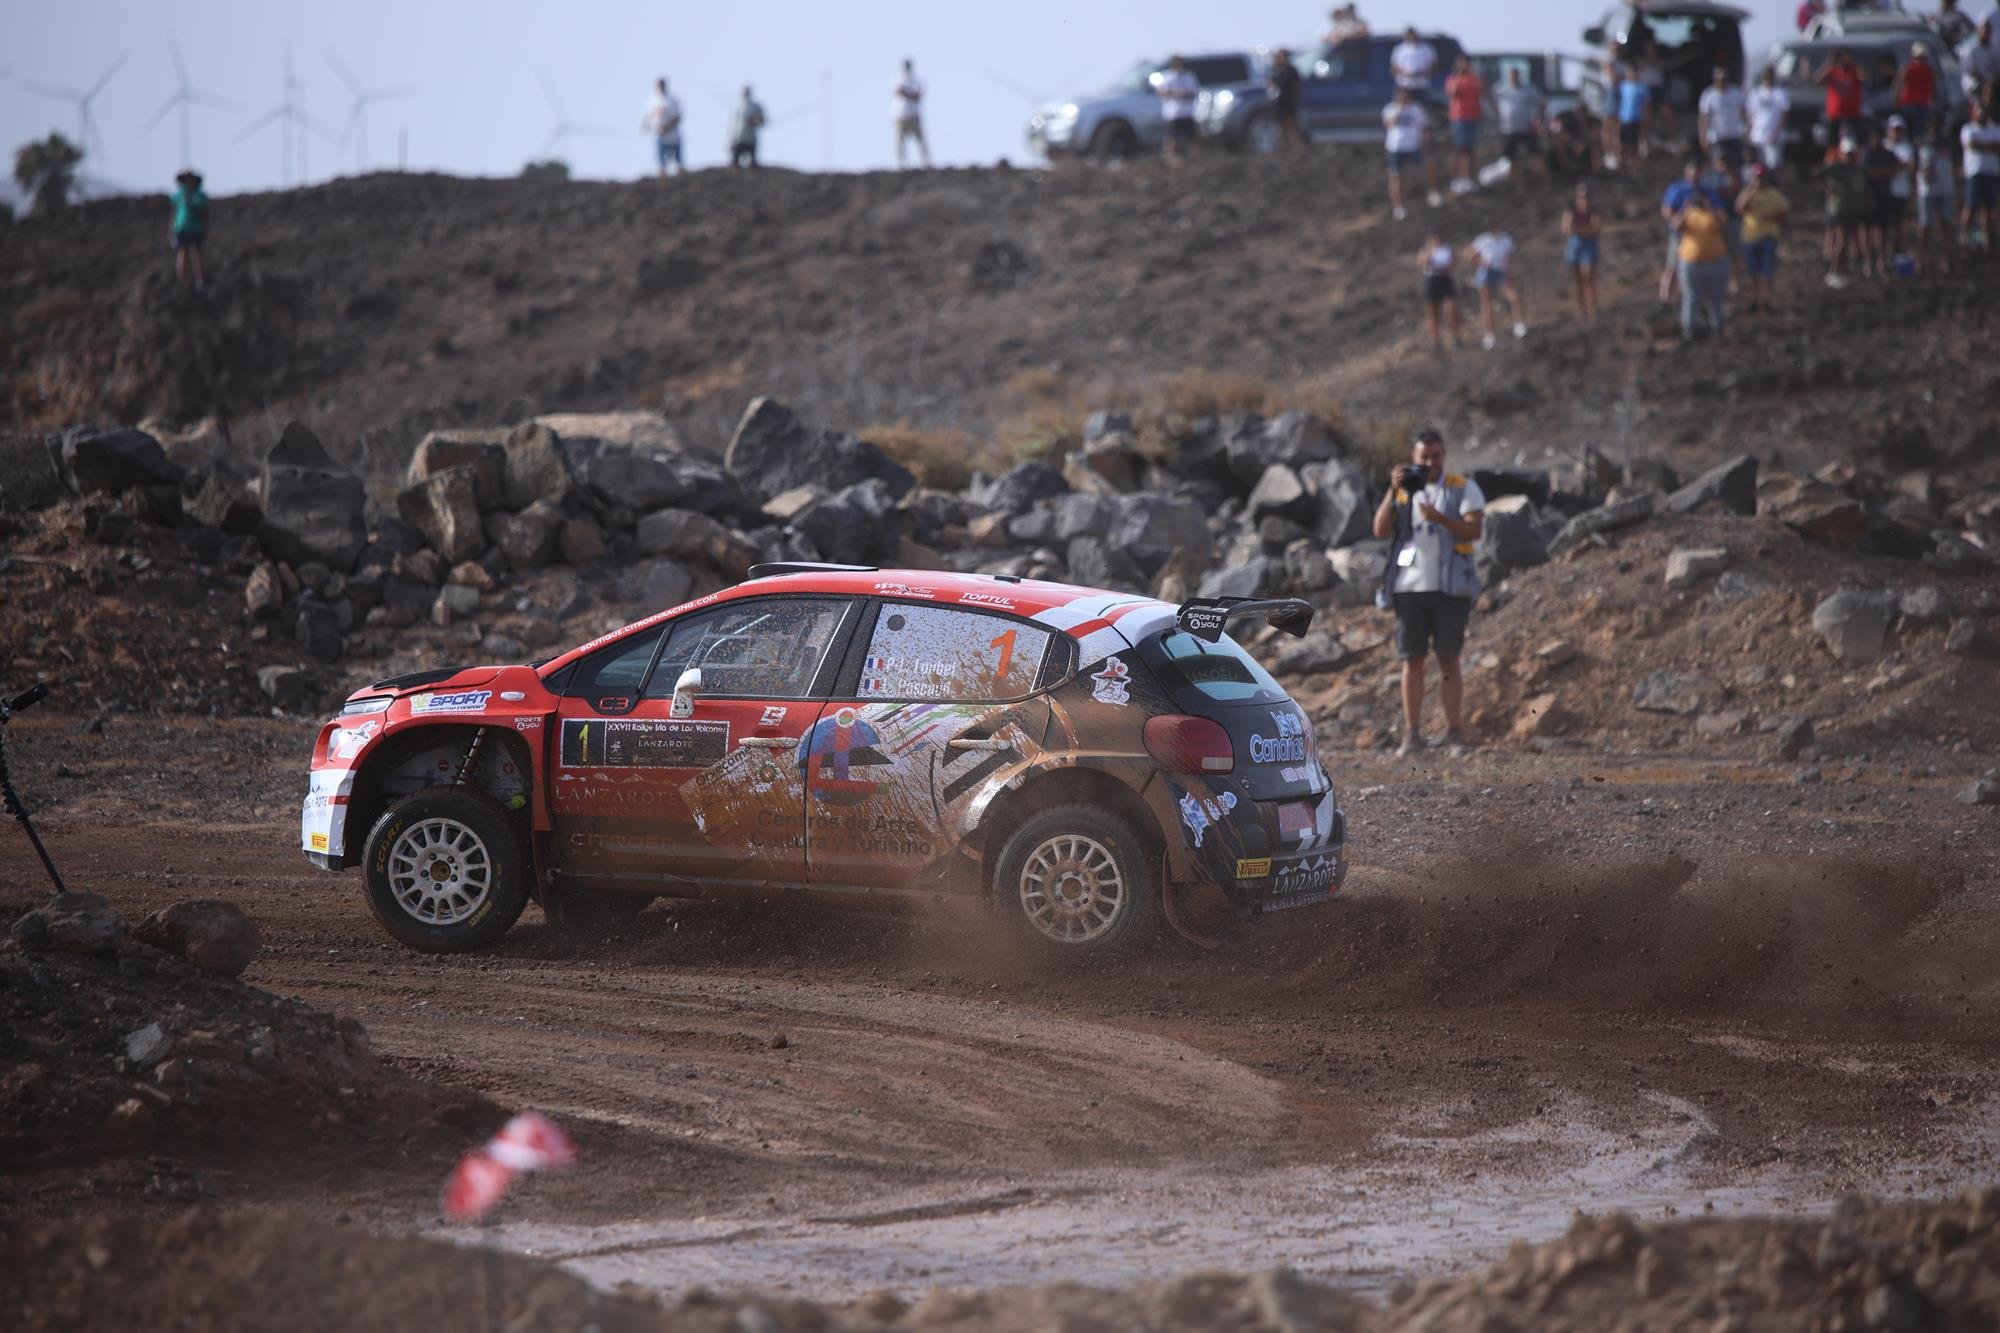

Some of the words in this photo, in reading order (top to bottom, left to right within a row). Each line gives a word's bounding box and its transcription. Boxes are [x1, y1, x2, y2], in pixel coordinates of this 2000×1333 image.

[962, 592, 1010, 605] TOPTUL
[580, 595, 718, 652] BOUTIQUE.CITROENRACING.COM
[1187, 612, 1221, 622] SPORTS
[990, 629, 1017, 678] 1
[600, 697, 629, 710] C3
[607, 723, 631, 731] XXVII
[632, 724, 653, 733] Rallye
[655, 724, 667, 732] Isla
[669, 724, 680, 732] de
[696, 724, 728, 734] Volcanes
[578, 723, 590, 762] 1
[638, 739, 694, 748] LANZAROTE
[1250, 734, 1305, 763] Canarias
[555, 784, 681, 806] LANZAROTE
[757, 808, 842, 830] Centros
[874, 814, 919, 834] Arte
